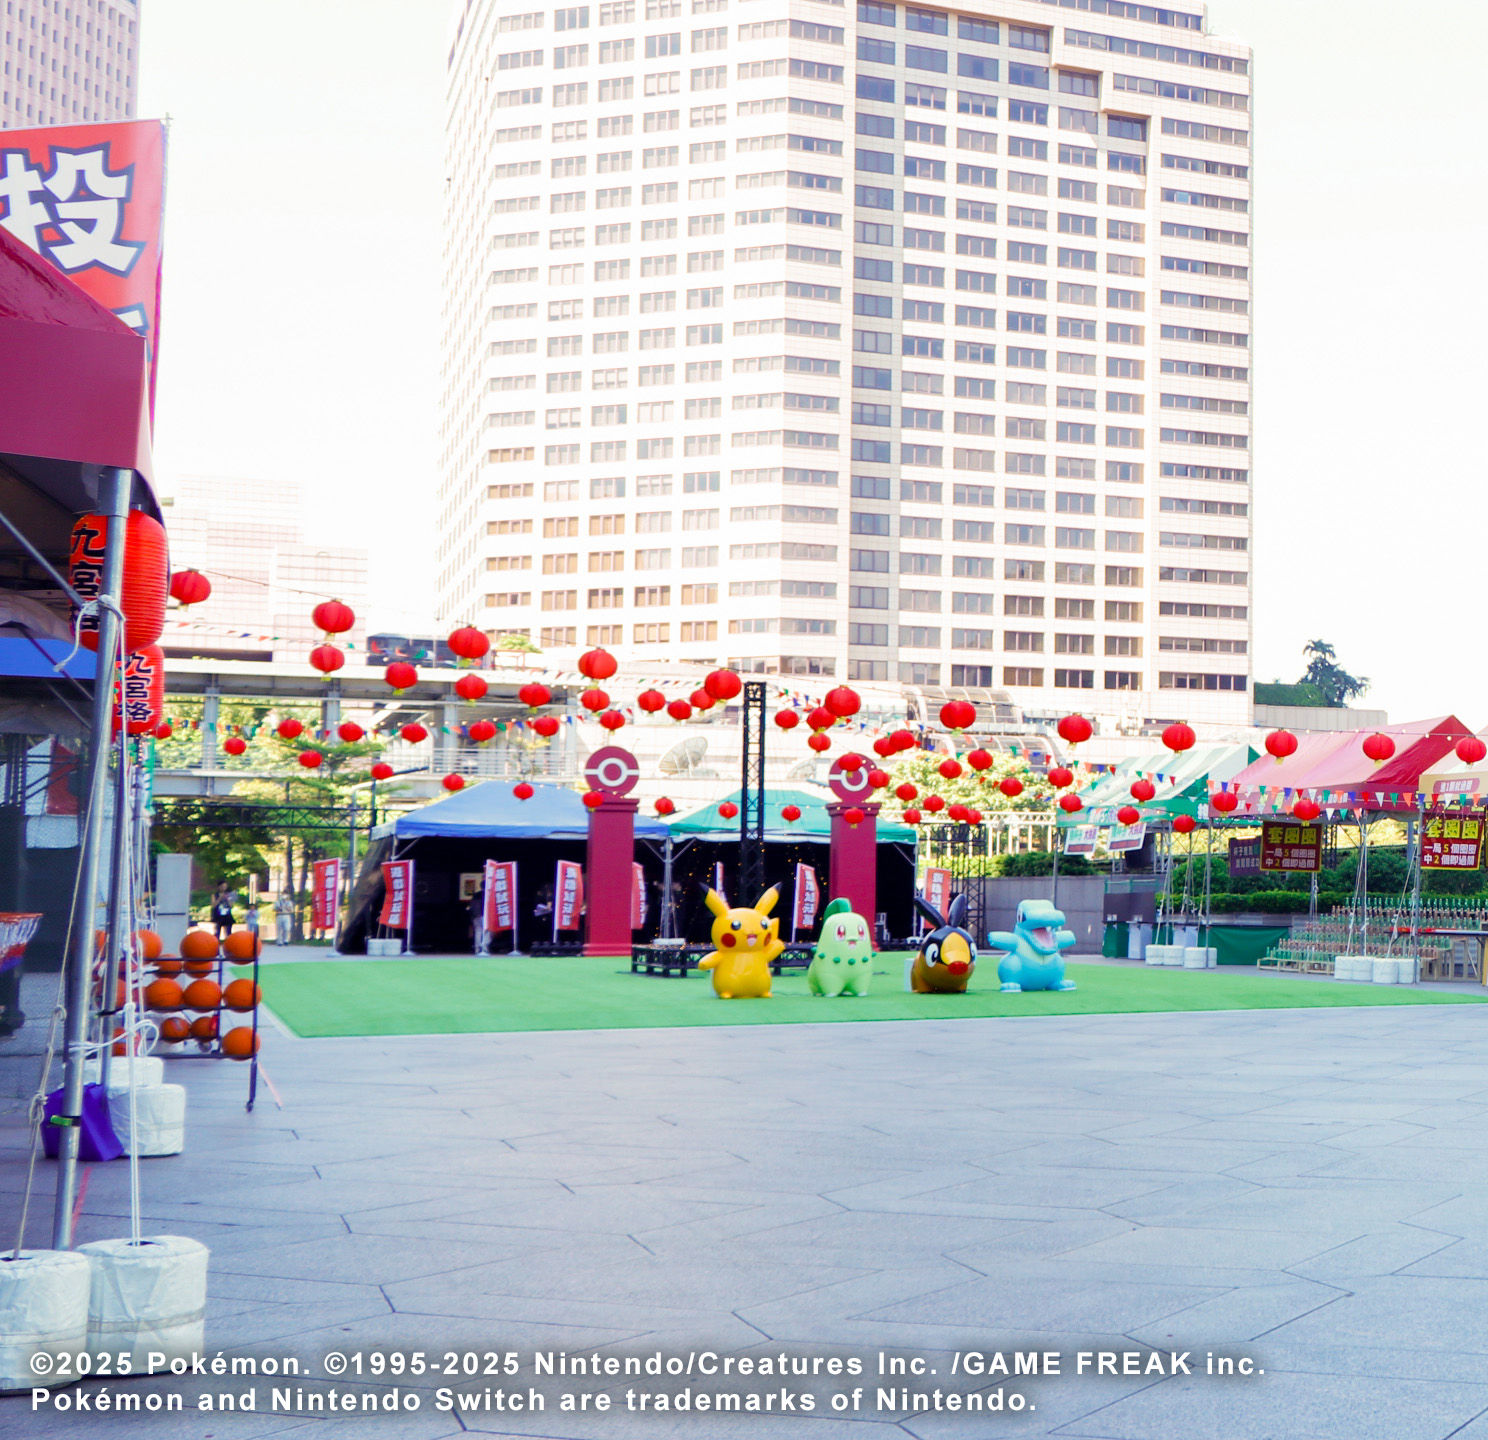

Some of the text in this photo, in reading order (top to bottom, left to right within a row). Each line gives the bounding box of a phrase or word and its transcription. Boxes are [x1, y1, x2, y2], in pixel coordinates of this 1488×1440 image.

[0, 141, 149, 338] 投
[118, 653, 153, 723] 九宮格
